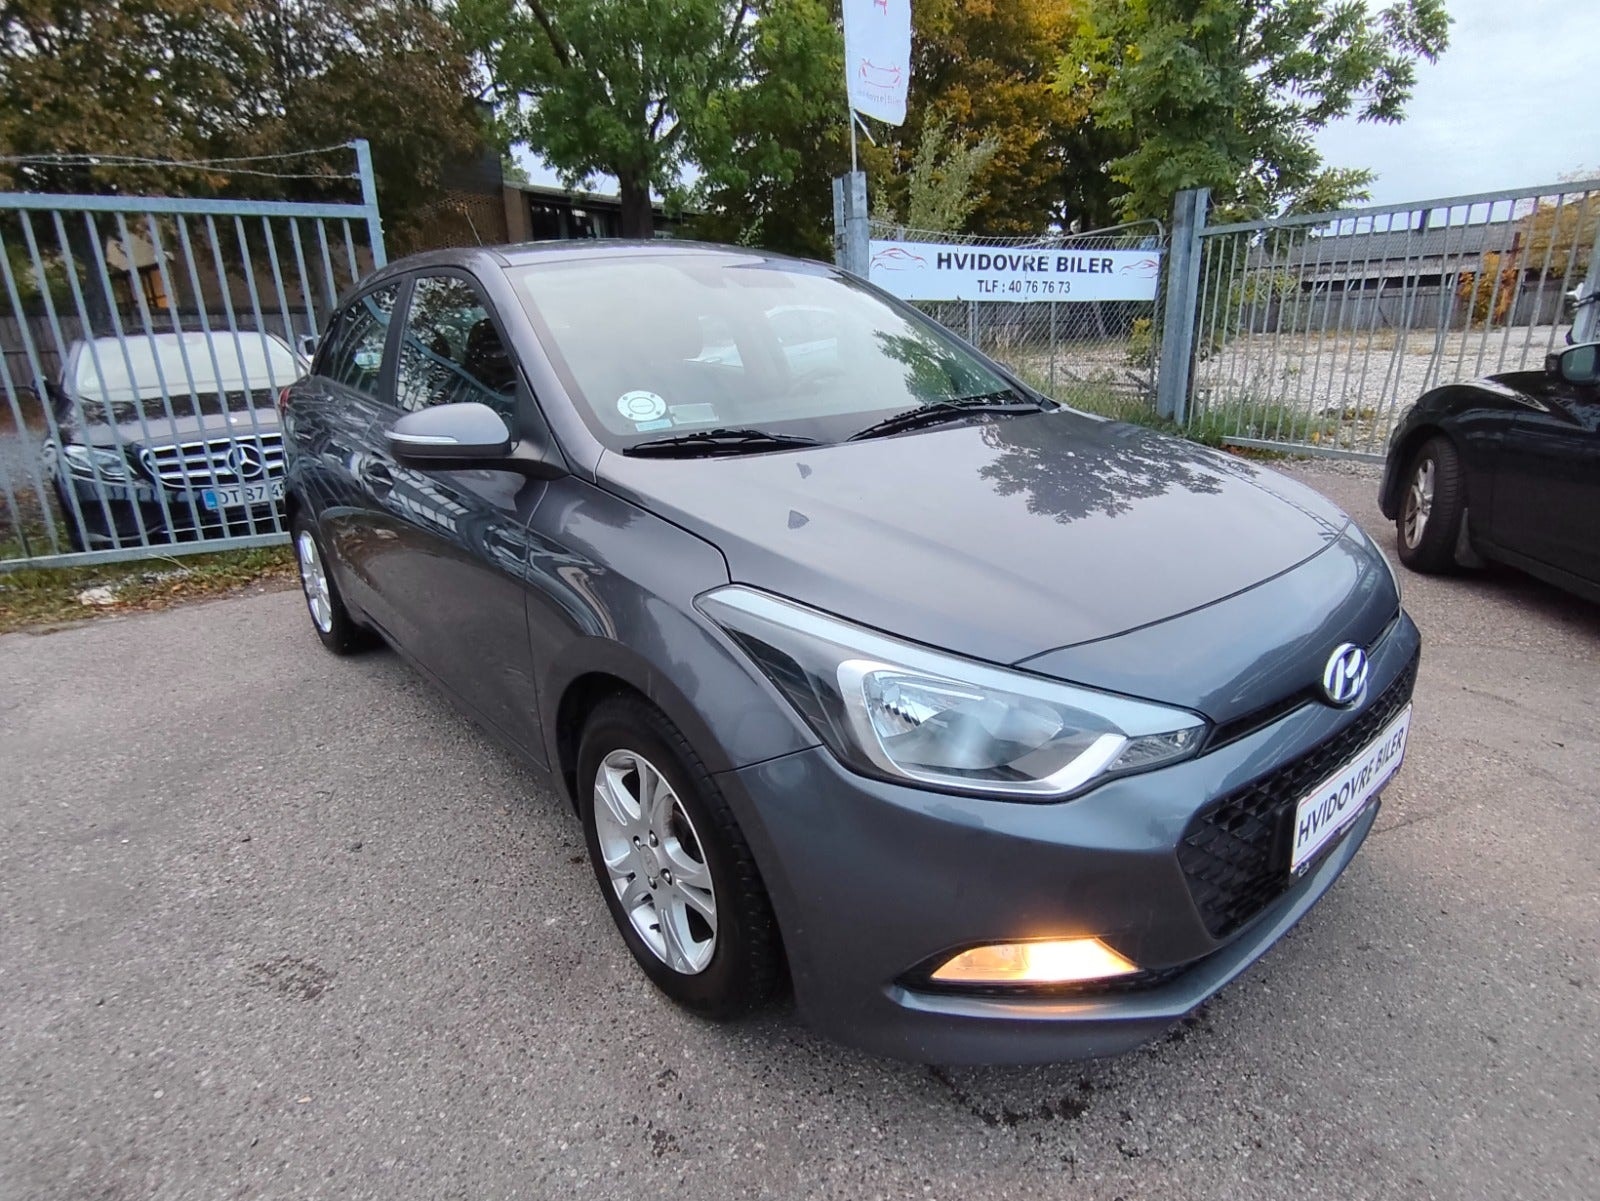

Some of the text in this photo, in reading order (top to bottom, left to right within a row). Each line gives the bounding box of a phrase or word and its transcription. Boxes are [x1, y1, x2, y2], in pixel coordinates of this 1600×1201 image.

[936, 252, 1114, 274] HVIDOVRE BILER
[977, 279, 999, 293] TLF
[1008, 280, 1022, 293] 40
[1025, 280, 1039, 293] 76
[1042, 280, 1055, 293] 76
[1058, 280, 1071, 293] 73
[1297, 727, 1405, 848] HVIDOVRE BILER
